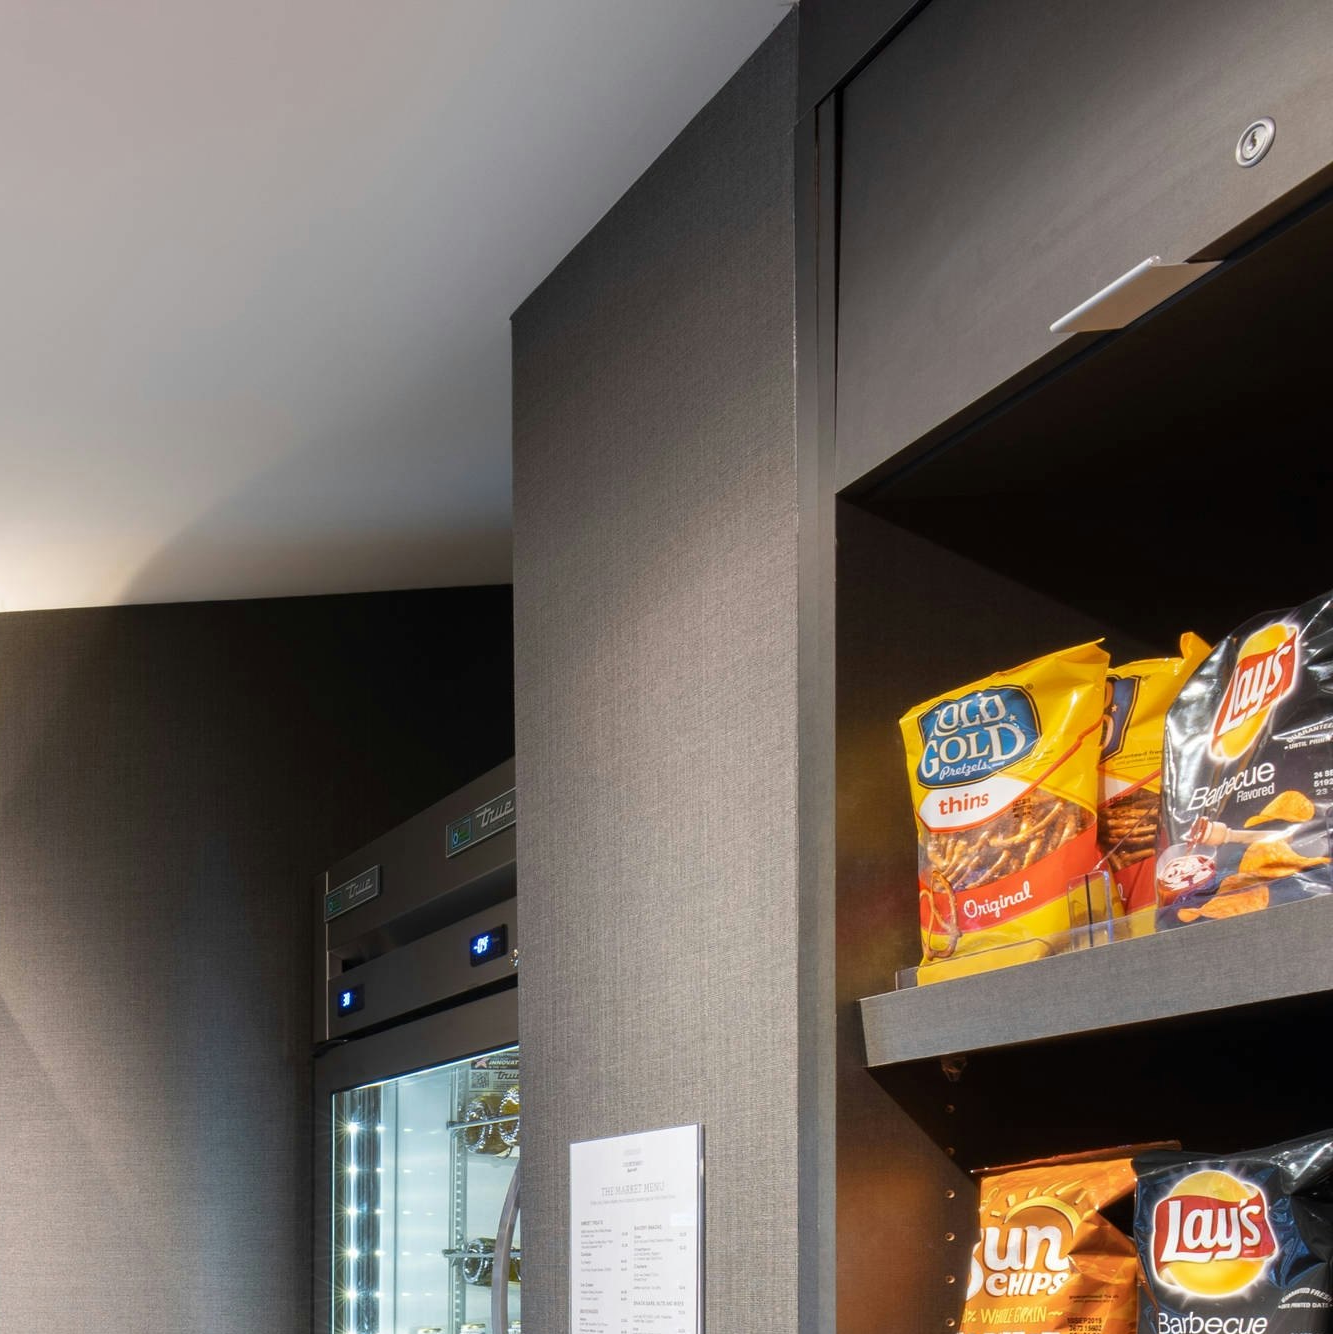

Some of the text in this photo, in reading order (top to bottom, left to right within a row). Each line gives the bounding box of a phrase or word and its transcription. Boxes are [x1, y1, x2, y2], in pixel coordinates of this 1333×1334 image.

[1217, 641, 1292, 737] Lay's
[921, 722, 1026, 778] GOLD
[939, 760, 990, 781] Pretzels
[1187, 761, 1276, 812] Barbecue
[938, 789, 990, 816] thins
[1236, 781, 1276, 803] Flavored
[963, 881, 1034, 919] Original
[601, 1186, 614, 1197] THE
[1160, 1198, 1263, 1264] Lay's
[985, 1271, 1070, 1297] CHIPS
